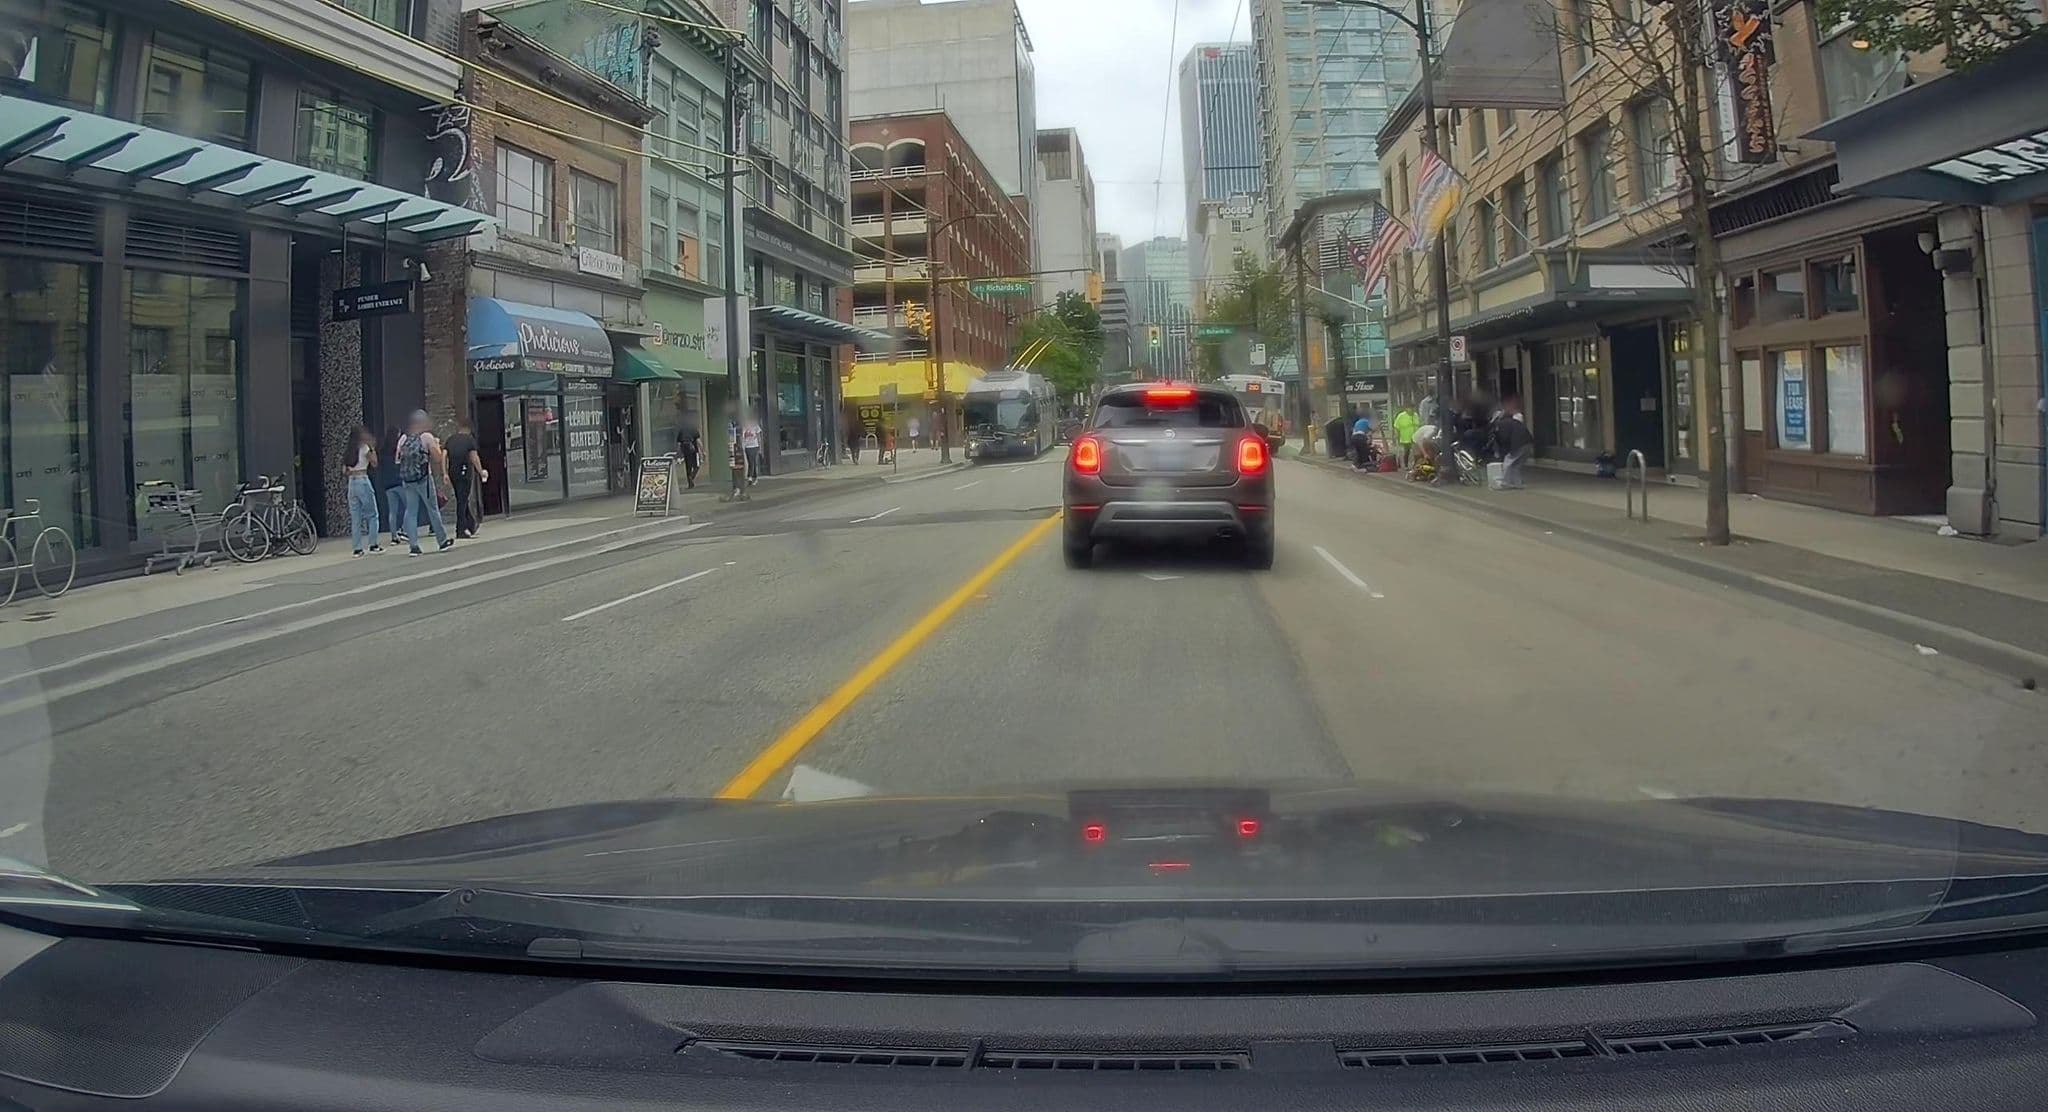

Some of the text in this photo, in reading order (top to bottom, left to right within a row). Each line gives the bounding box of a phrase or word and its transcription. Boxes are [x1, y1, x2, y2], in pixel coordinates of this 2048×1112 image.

[986, 283, 1013, 291] Richards
[517, 322, 580, 358] Pholicious
[473, 359, 515, 372] Pholicious
[1787, 383, 1800, 396] FOR
[1785, 396, 1803, 409] LEASE
[570, 430, 601, 447] BARTEND
